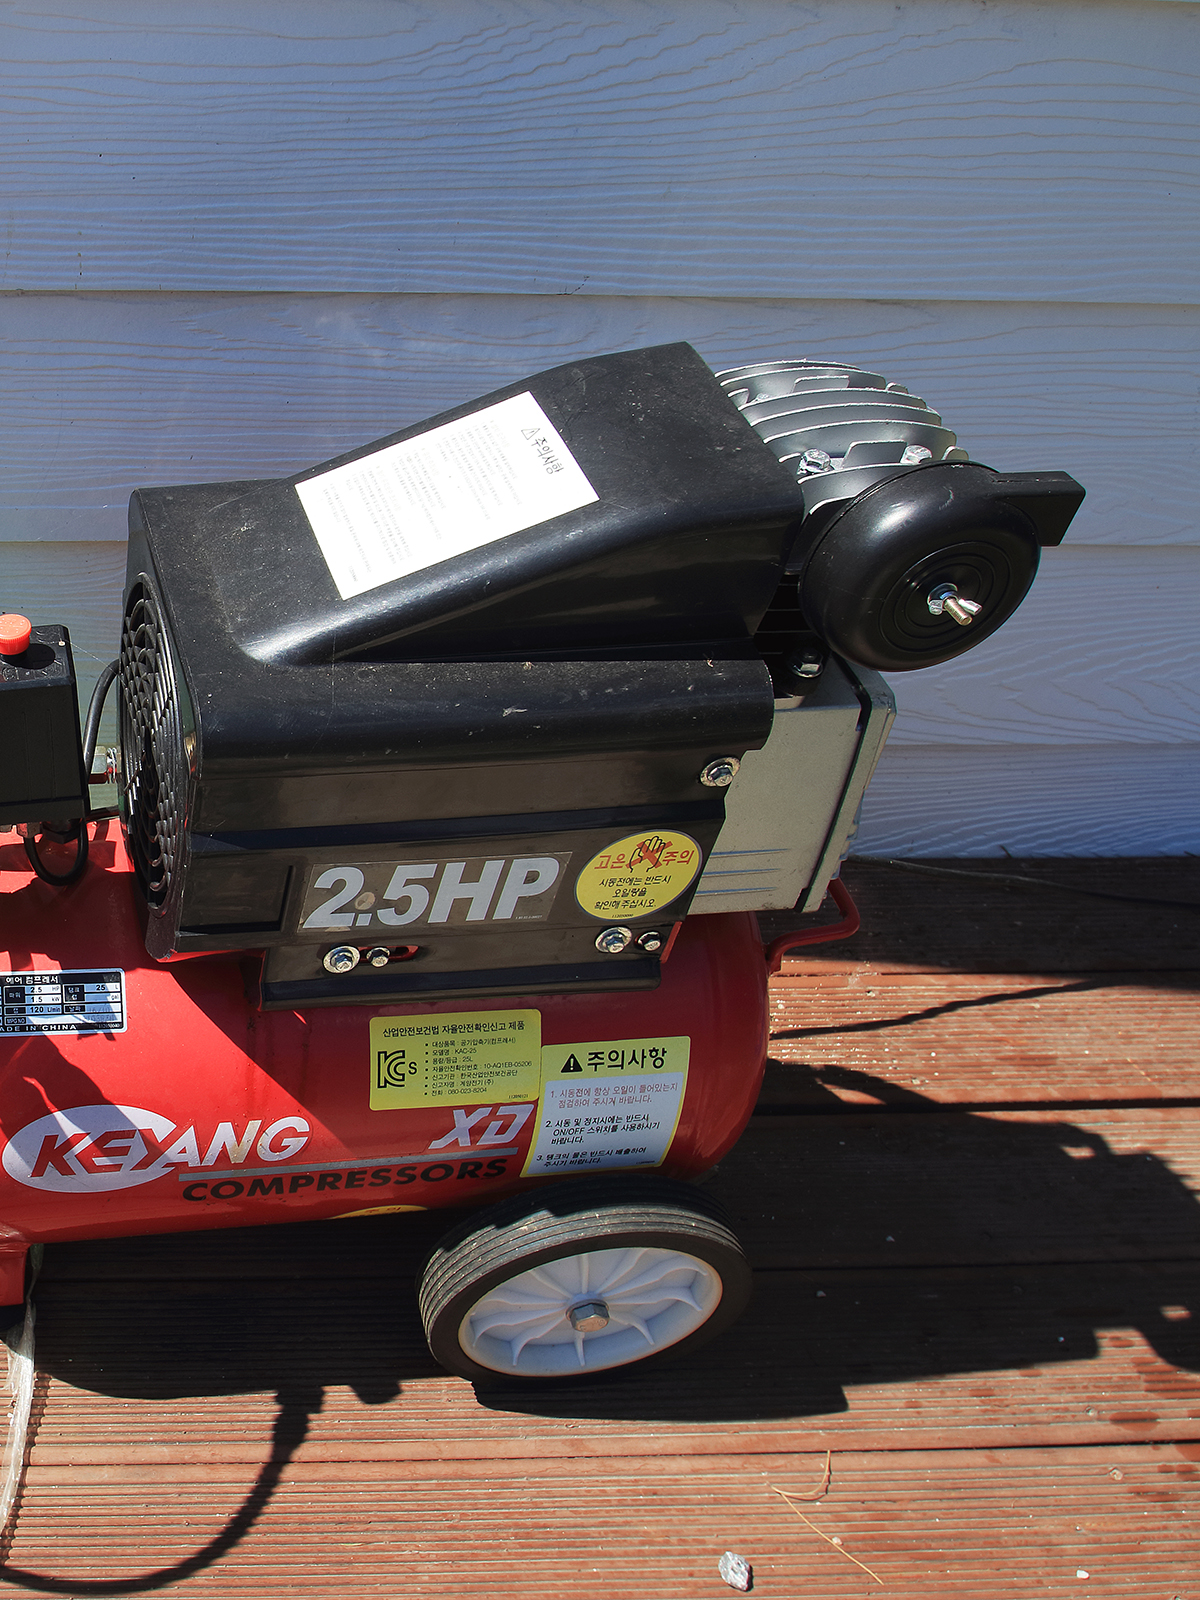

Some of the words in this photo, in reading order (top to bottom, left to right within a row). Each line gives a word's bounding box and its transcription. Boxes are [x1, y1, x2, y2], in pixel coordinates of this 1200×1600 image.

[531, 437, 564, 475] 주의사항
[594, 853, 626, 870] 고온
[662, 850, 695, 866] 주의
[599, 877, 643, 888] 시동전에는
[644, 875, 672, 886] 반드시
[302, 856, 560, 929] 2.5HP
[594, 900, 620, 910] 확인해
[25, 975, 60, 985] 컴프레서
[382, 1025, 440, 1038] 산업안전보건법
[441, 1022, 507, 1034] 자율안전확인신고
[508, 1020, 525, 1031] 제품
[587, 1046, 668, 1072] 주의사항
[560, 1087, 592, 1099] 시동전에
[594, 1085, 610, 1096] 항상
[612, 1084, 637, 1096] 오일이
[638, 1082, 678, 1094] 들어있는지
[558, 1098, 590, 1109] 점검하여
[428, 1104, 535, 1150] XD
[555, 1118, 571, 1128] 시동
[625, 1113, 650, 1122] 반드시
[552, 1126, 586, 1136] ON/OFF
[30, 1116, 311, 1178] KEYANG
[182, 1158, 508, 1202] COMPRESSORS
